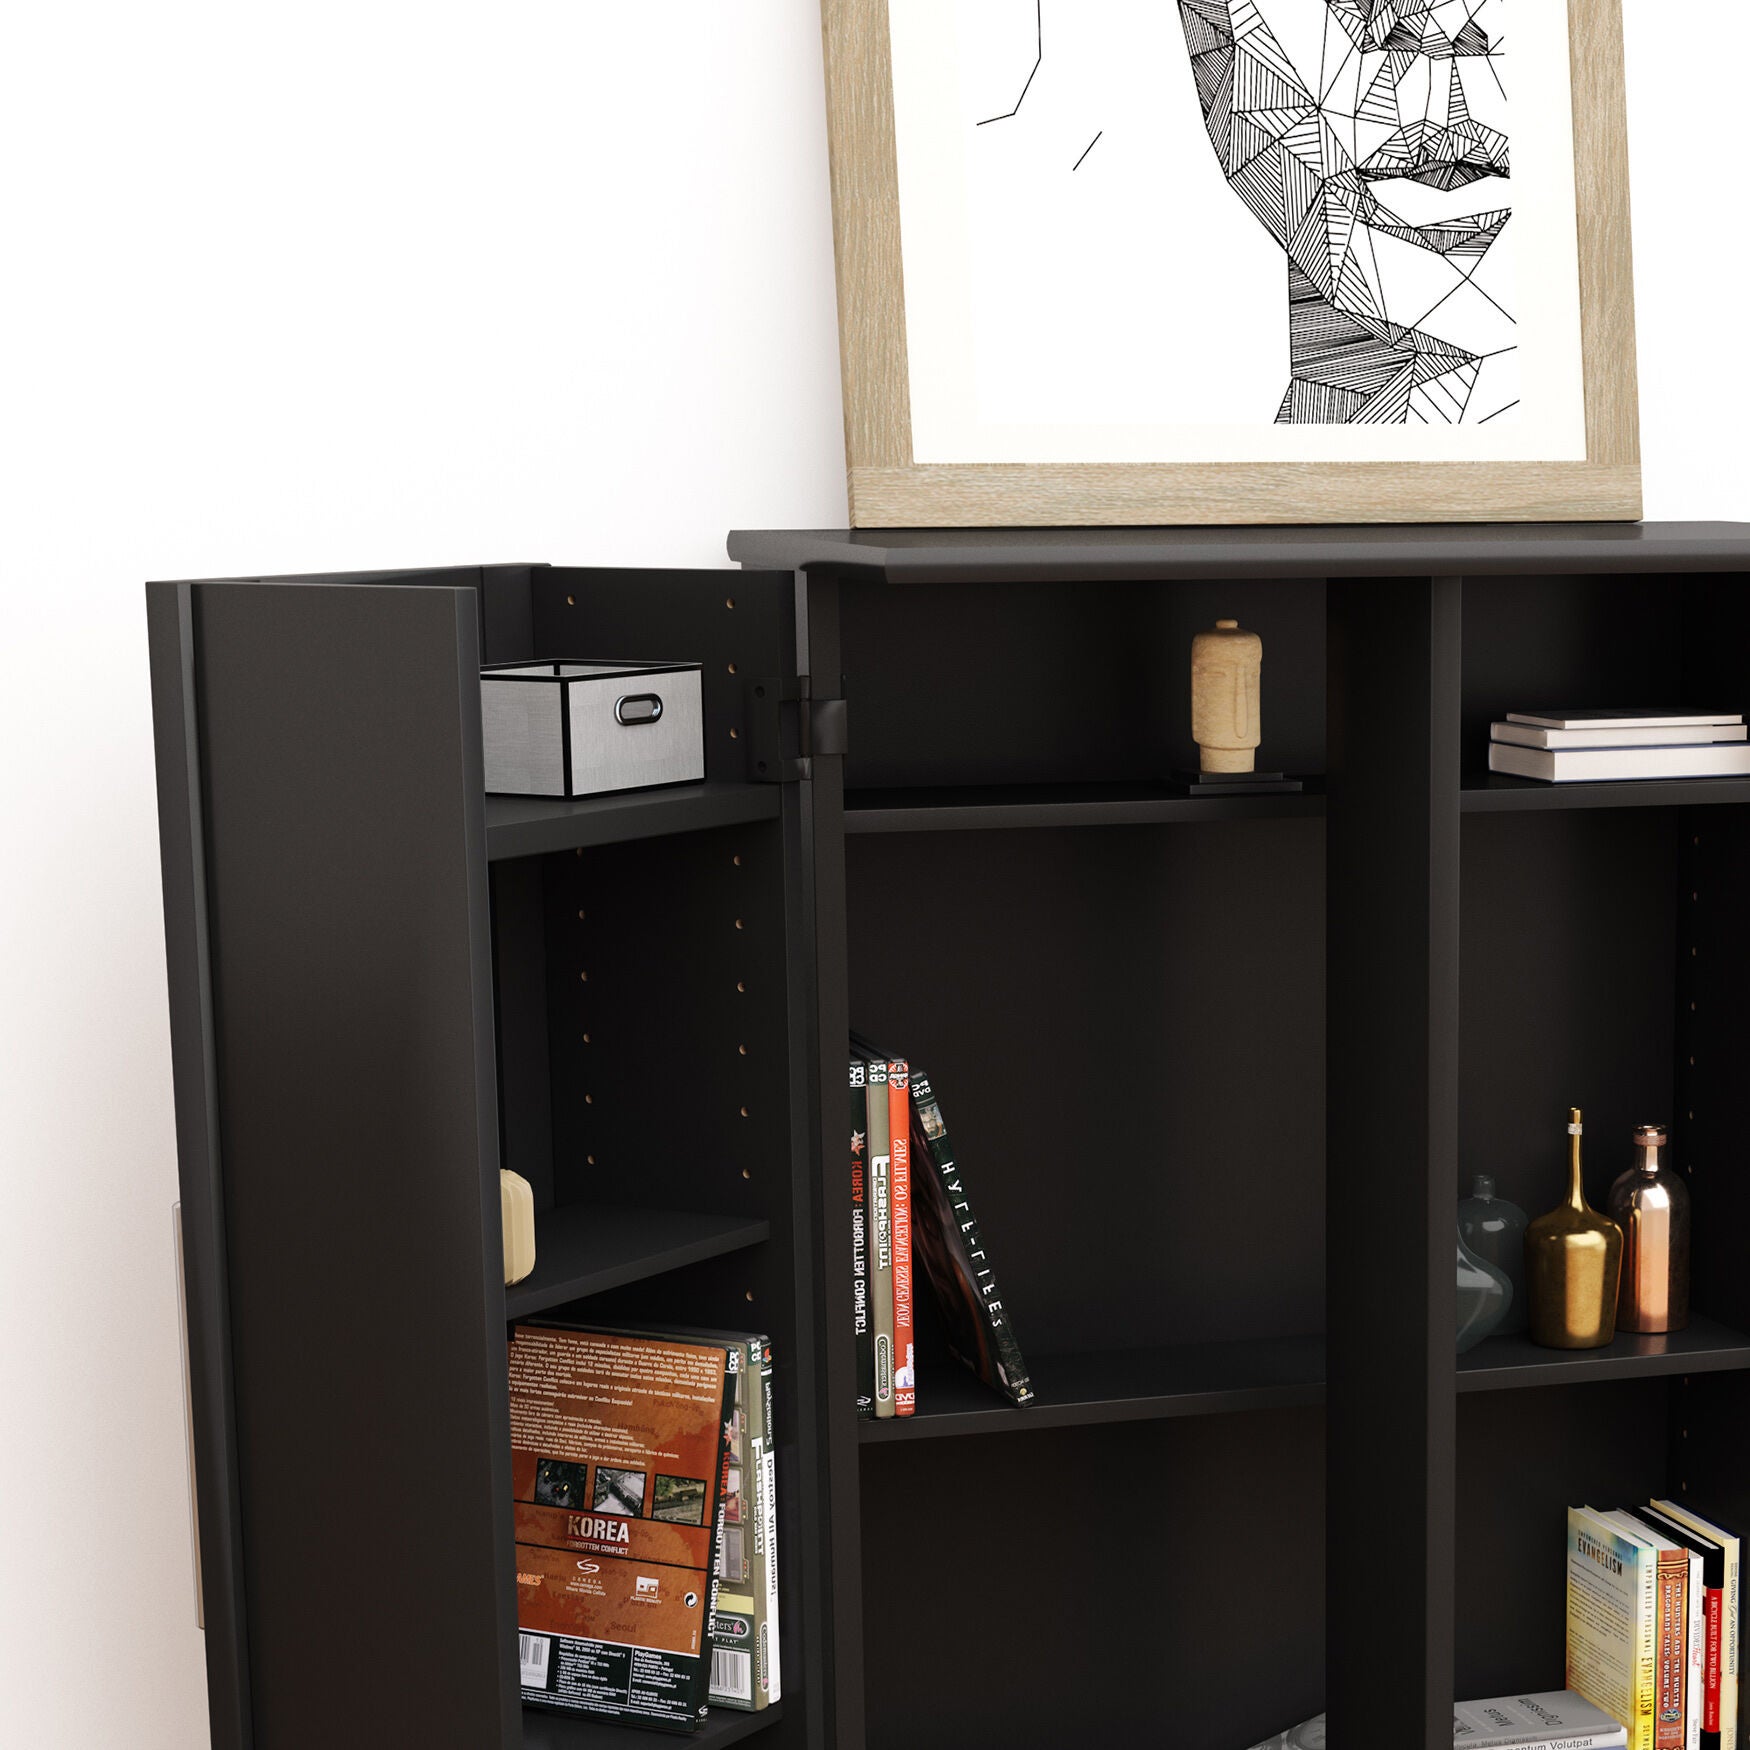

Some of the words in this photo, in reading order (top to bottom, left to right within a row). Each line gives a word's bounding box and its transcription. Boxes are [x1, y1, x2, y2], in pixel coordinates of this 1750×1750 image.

[568, 1514, 630, 1544] KOREA
[566, 1540, 600, 1552] FORGOTTEN
[600, 1544, 629, 1556] CONFLICT
[1578, 1538, 1623, 1576] EVANGELISM
[707, 1579, 720, 1640] CONFLICT
[1710, 1602, 1718, 1624] BICYCLE
[1710, 1624, 1718, 1640] BUILT
[1730, 1620, 1736, 1630] AN
[1728, 1630, 1736, 1676] OPPORTUNITY
[1640, 1657, 1653, 1716] EVANGELISM
[1484, 1708, 1515, 1727] Metus
[1518, 1698, 1562, 1726] Dignissim
[1550, 1738, 1593, 1750] Volutpat
